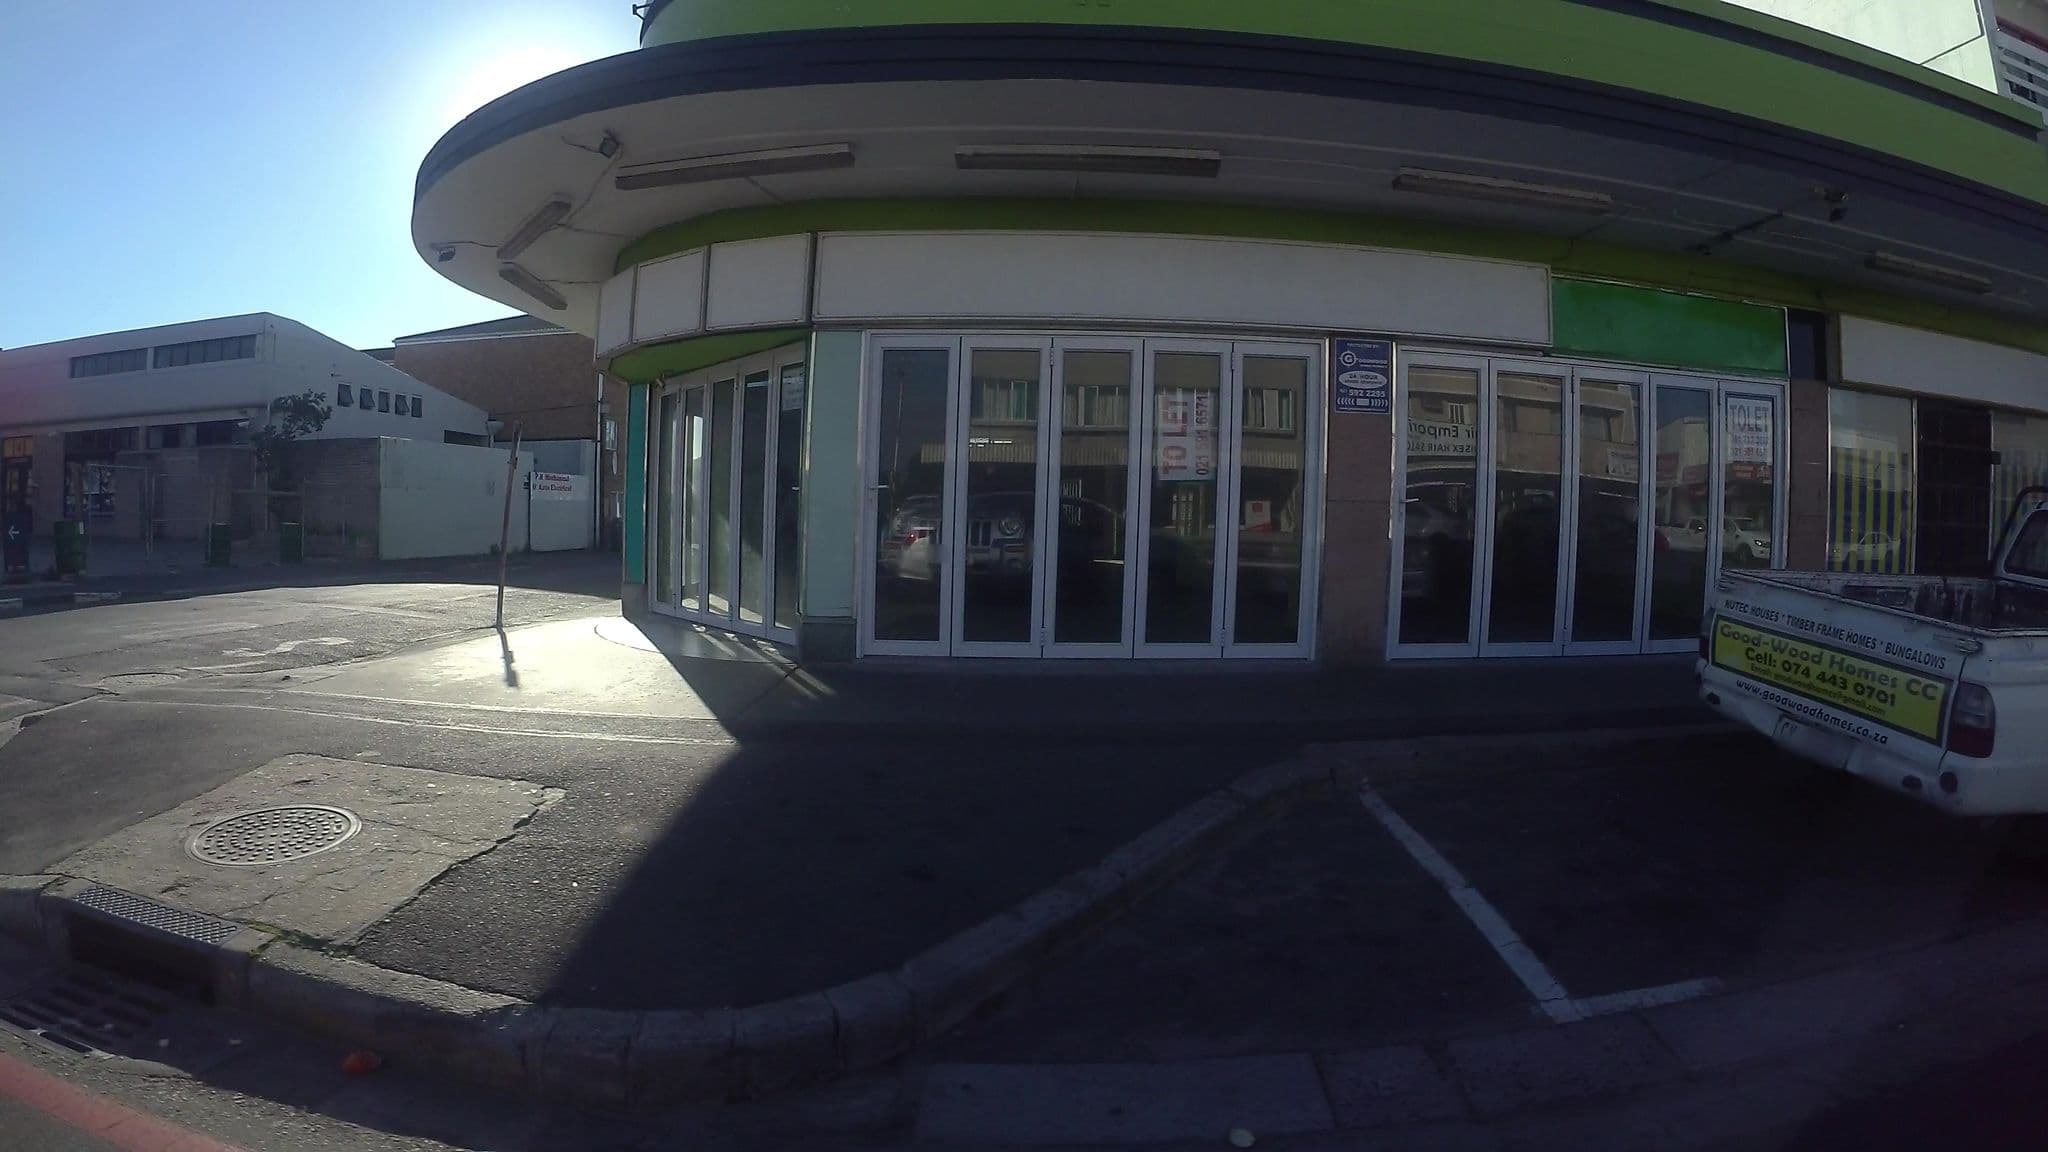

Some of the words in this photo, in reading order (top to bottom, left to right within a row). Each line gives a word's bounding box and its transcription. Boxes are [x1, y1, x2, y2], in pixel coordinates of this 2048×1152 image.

[1162, 445, 1188, 475] TO
[1719, 623, 1824, 666] Good-Wood
[1828, 654, 1897, 689] Homes
[1905, 677, 1938, 701] CC
[1724, 600, 1749, 614] NUTEC
[1750, 604, 1780, 622] HOUSES
[1786, 614, 1816, 633] TIMBER
[1815, 622, 1846, 641] FRAME
[1845, 631, 1877, 650] HOMES
[1885, 641, 1946, 670] BUNGALOWS
[1745, 646, 1776, 668] Cell:
[1781, 659, 1811, 679] 074
[1816, 670, 1848, 690] 443
[1853, 681, 1896, 707] 0701
[1736, 679, 1889, 745] www.goodwoodhomes.co.za
